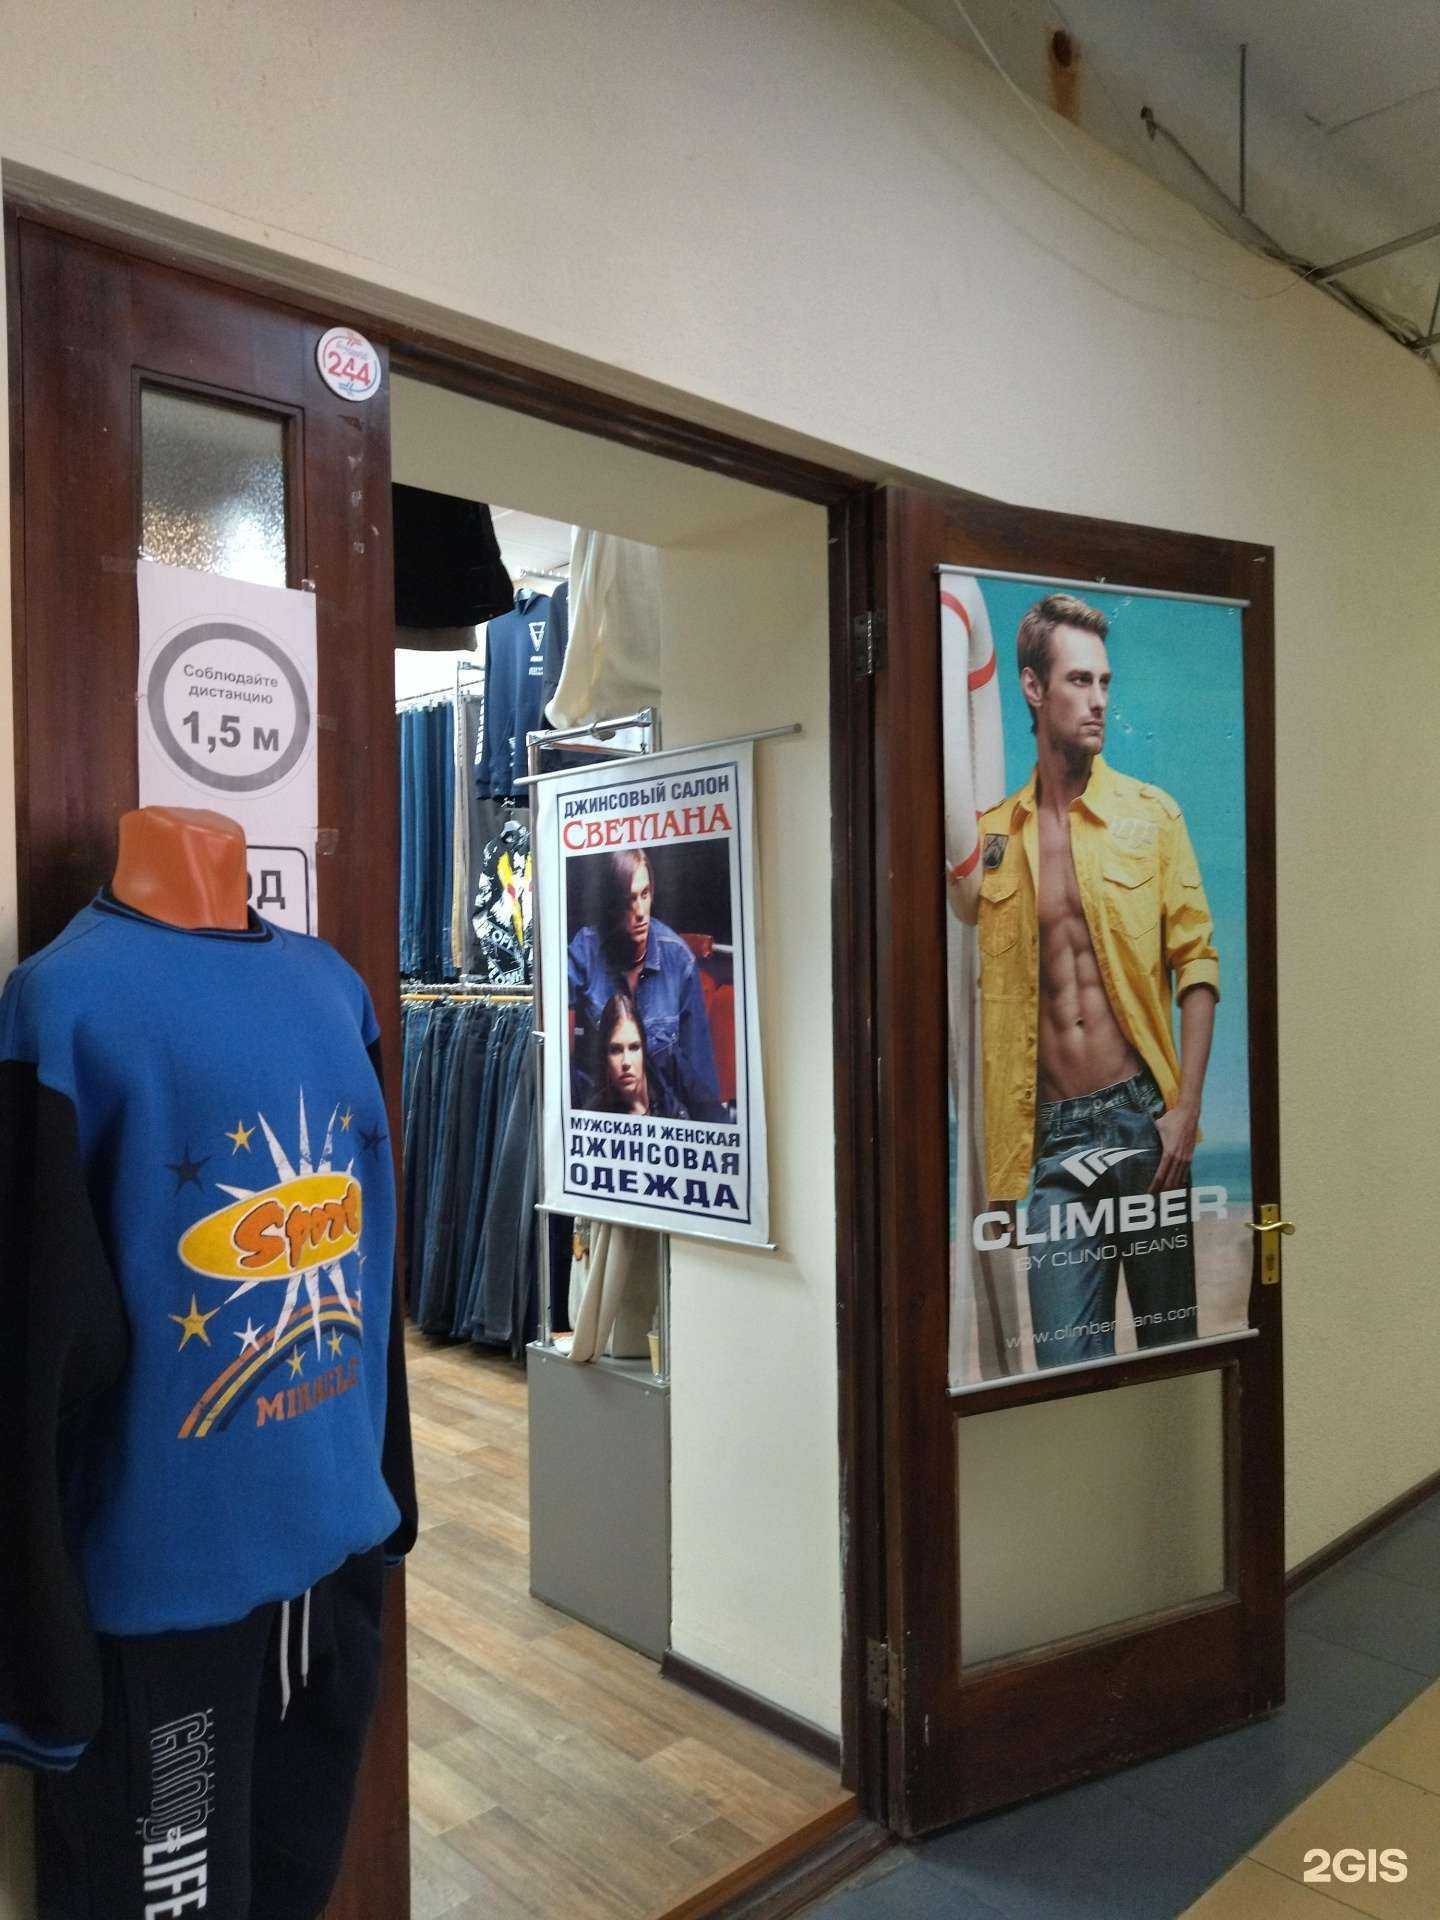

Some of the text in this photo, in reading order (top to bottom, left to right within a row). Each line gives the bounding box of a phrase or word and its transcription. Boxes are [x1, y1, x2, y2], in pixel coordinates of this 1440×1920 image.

[327, 351, 371, 386] 244
[183, 664, 279, 688] Соблюдайте
[188, 684, 273, 704] дистанцию
[182, 711, 279, 753] 1,5 м
[564, 775, 729, 819] ДЖИНСОВЫЙ САЛОН
[563, 803, 732, 850] СВЕТЛАНА
[570, 1117, 740, 1148] МУЖСКАЯ И ЖЕНСКАЯ
[570, 1134, 740, 1176] ДЖИНСОВАЯ
[570, 1163, 740, 1210] ОДЕЖДА
[973, 1185, 1229, 1251] CLIMBER
[1015, 1252, 1048, 1273] BY
[1122, 1234, 1189, 1258] JEANS
[143, 1826, 208, 1920] LIFE
